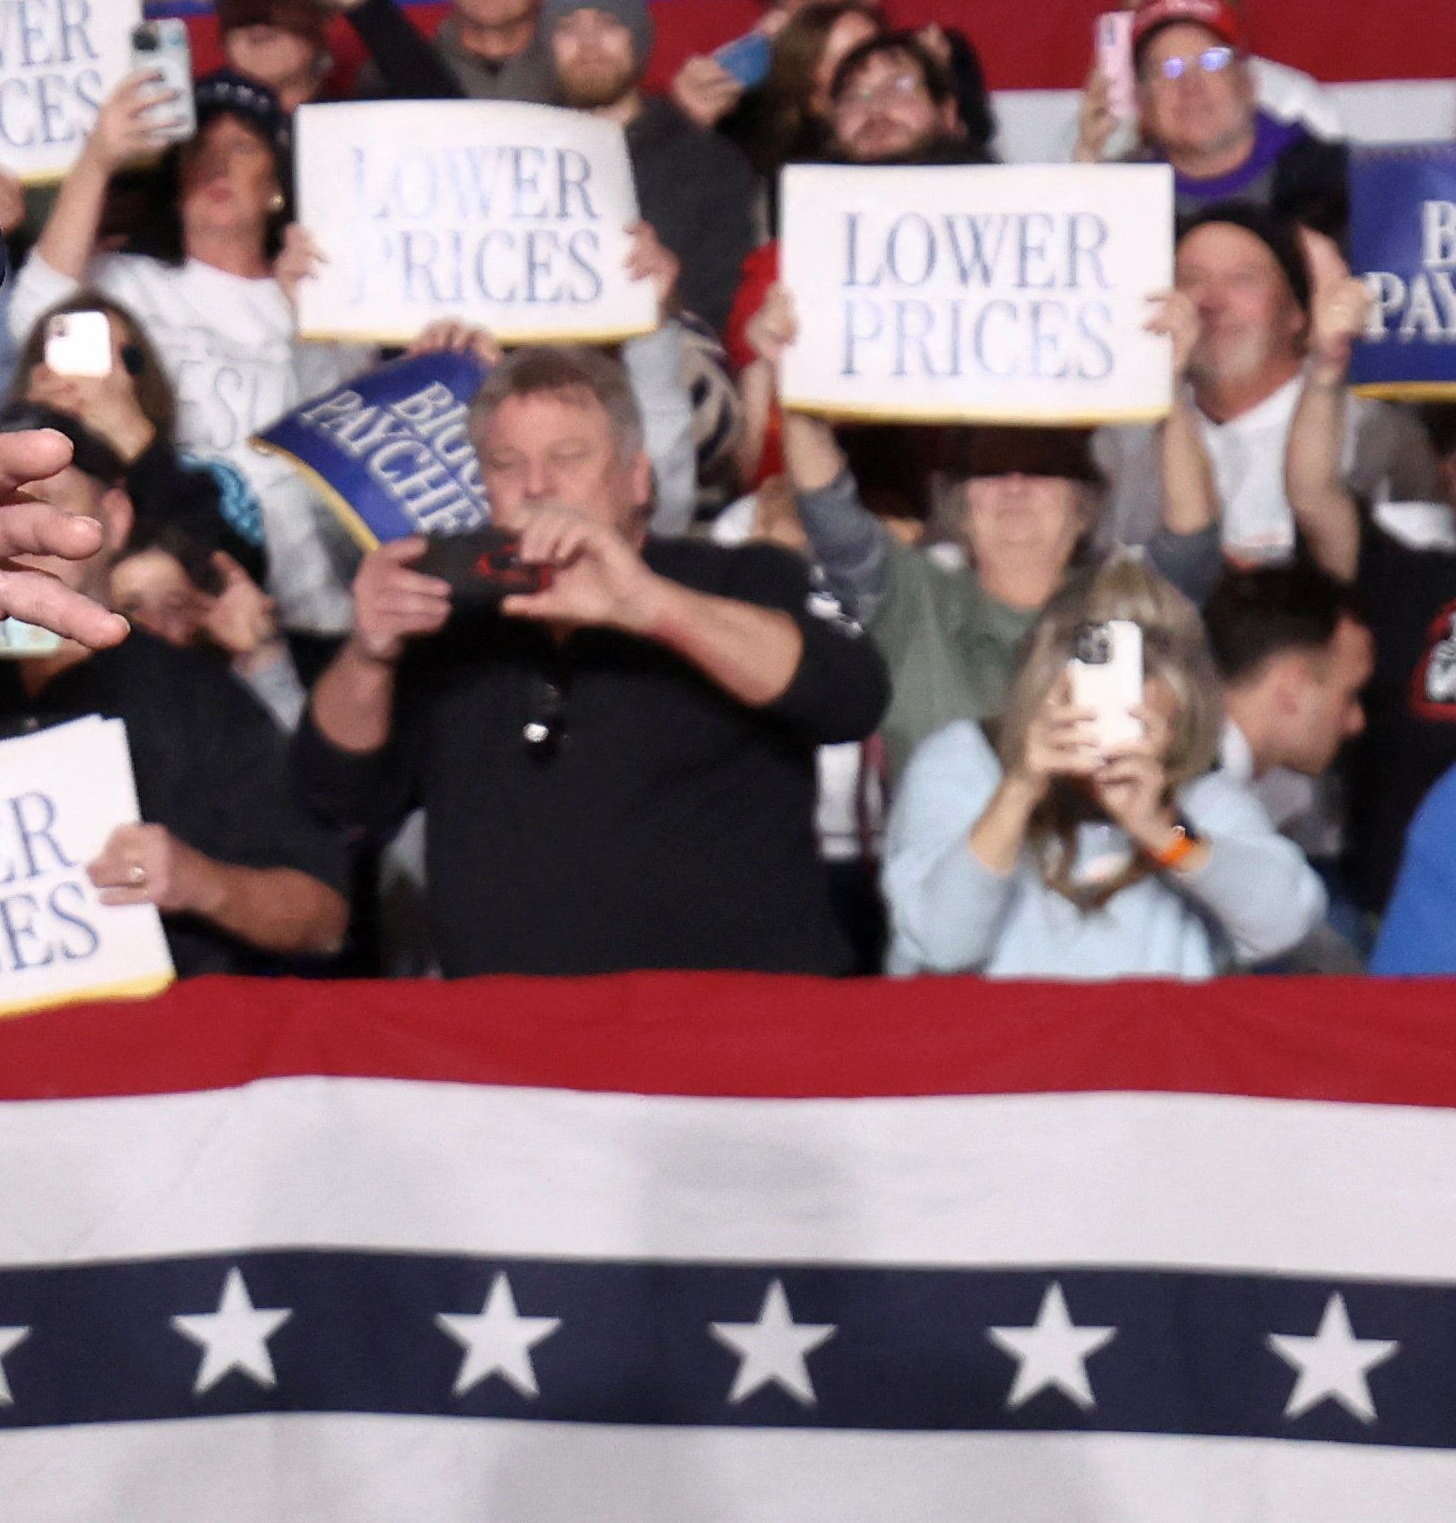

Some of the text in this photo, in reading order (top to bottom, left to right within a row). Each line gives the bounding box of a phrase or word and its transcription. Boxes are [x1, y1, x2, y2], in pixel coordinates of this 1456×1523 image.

[350, 144, 602, 221] LOWER
[347, 228, 605, 305] PRICES
[840, 210, 1114, 290] LOWER
[839, 298, 1117, 381] PRICES
